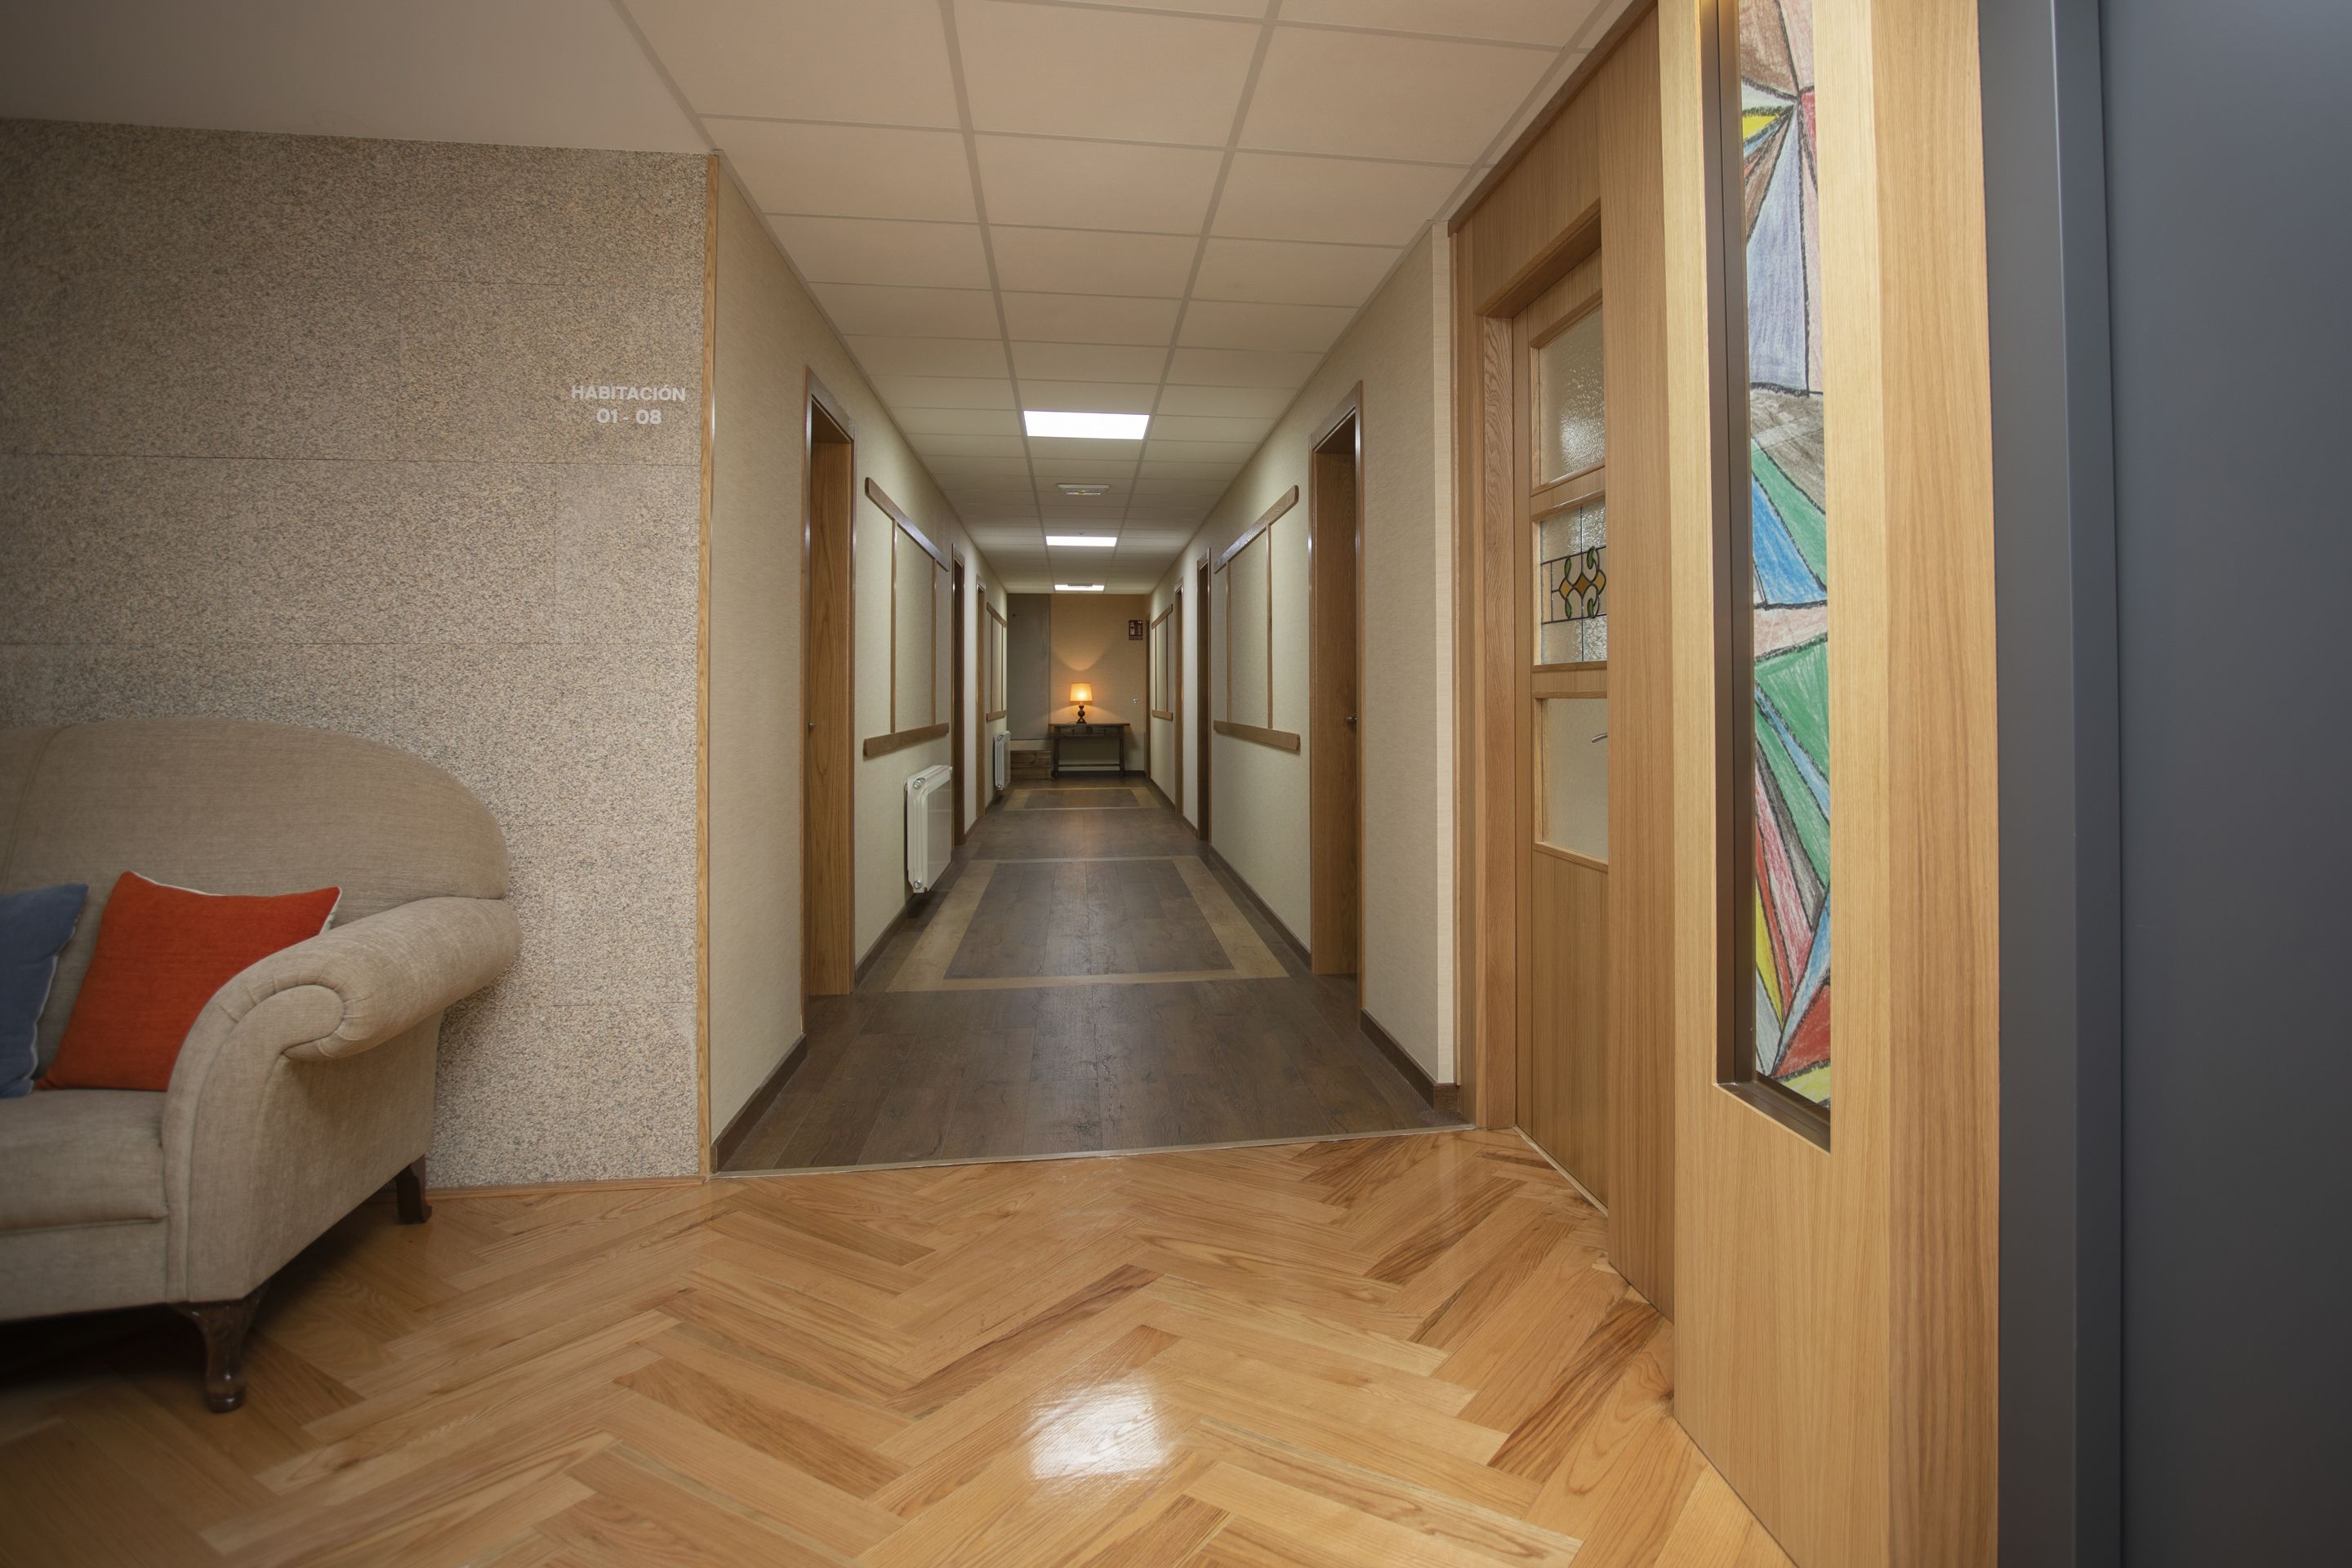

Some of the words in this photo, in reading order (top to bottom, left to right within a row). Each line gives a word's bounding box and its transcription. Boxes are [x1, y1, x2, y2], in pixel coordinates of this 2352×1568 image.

[572, 385, 686, 401] HABITACIÓN
[596, 408, 618, 423] 01
[635, 409, 662, 425] 08
